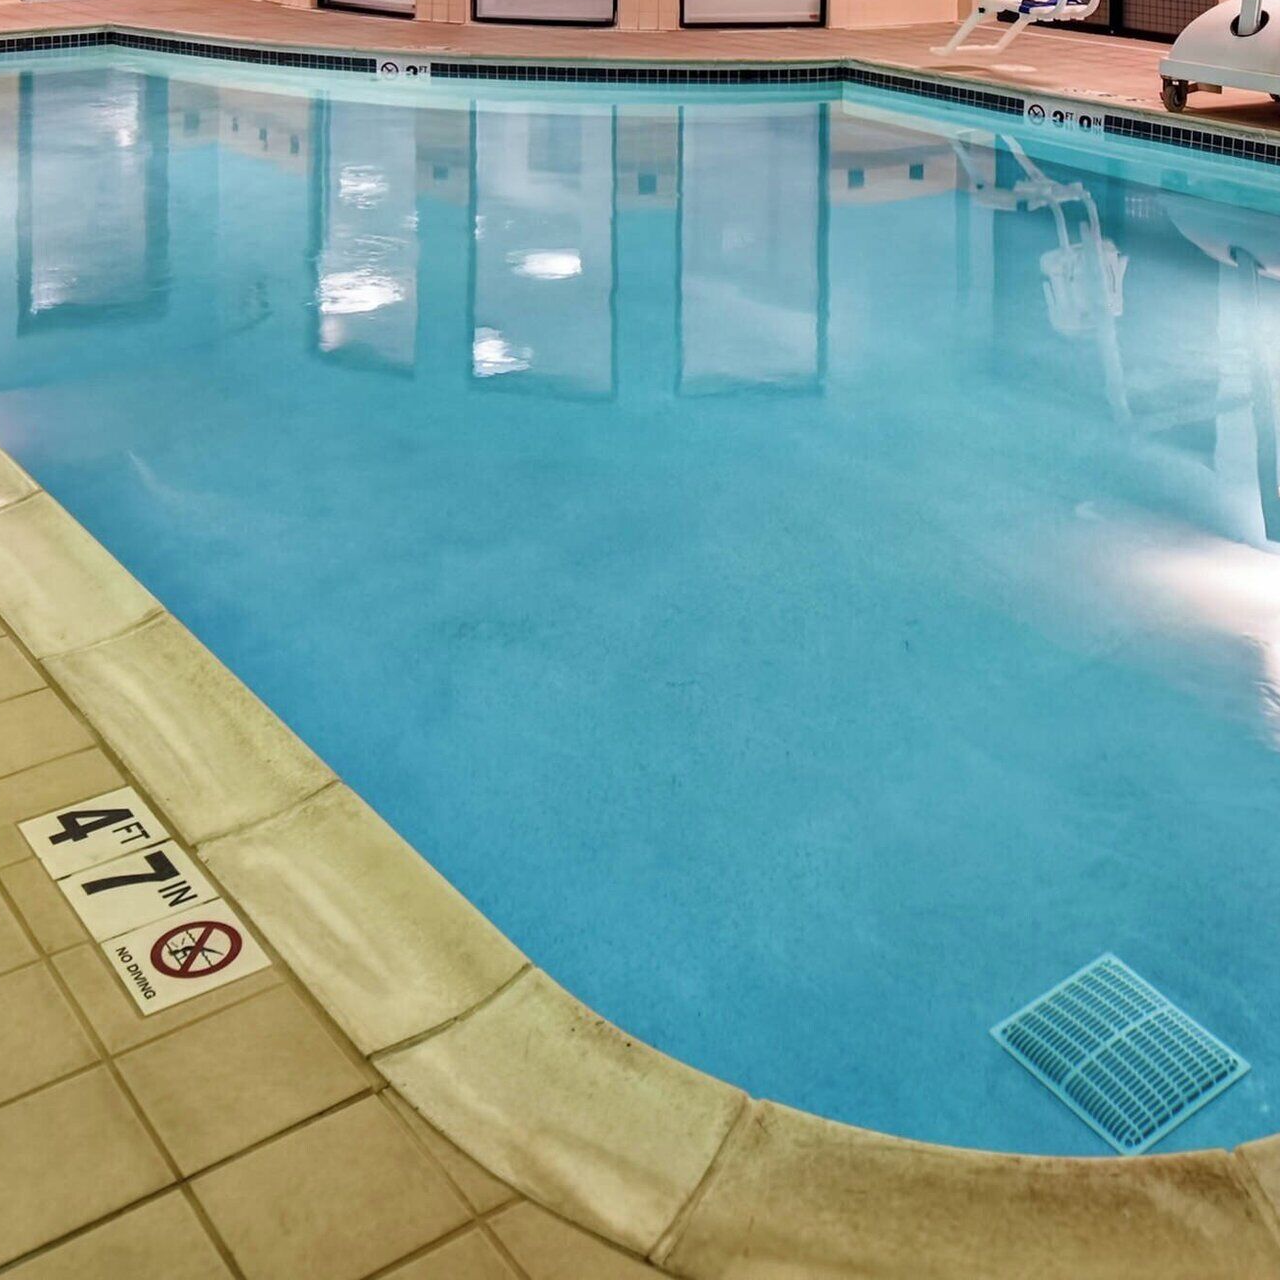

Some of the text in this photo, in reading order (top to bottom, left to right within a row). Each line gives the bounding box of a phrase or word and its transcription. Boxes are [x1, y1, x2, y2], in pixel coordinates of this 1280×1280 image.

[49, 809, 150, 845] 4 FT
[81, 850, 198, 907] 7 IN
[116, 946, 156, 1000] NO DIVING
